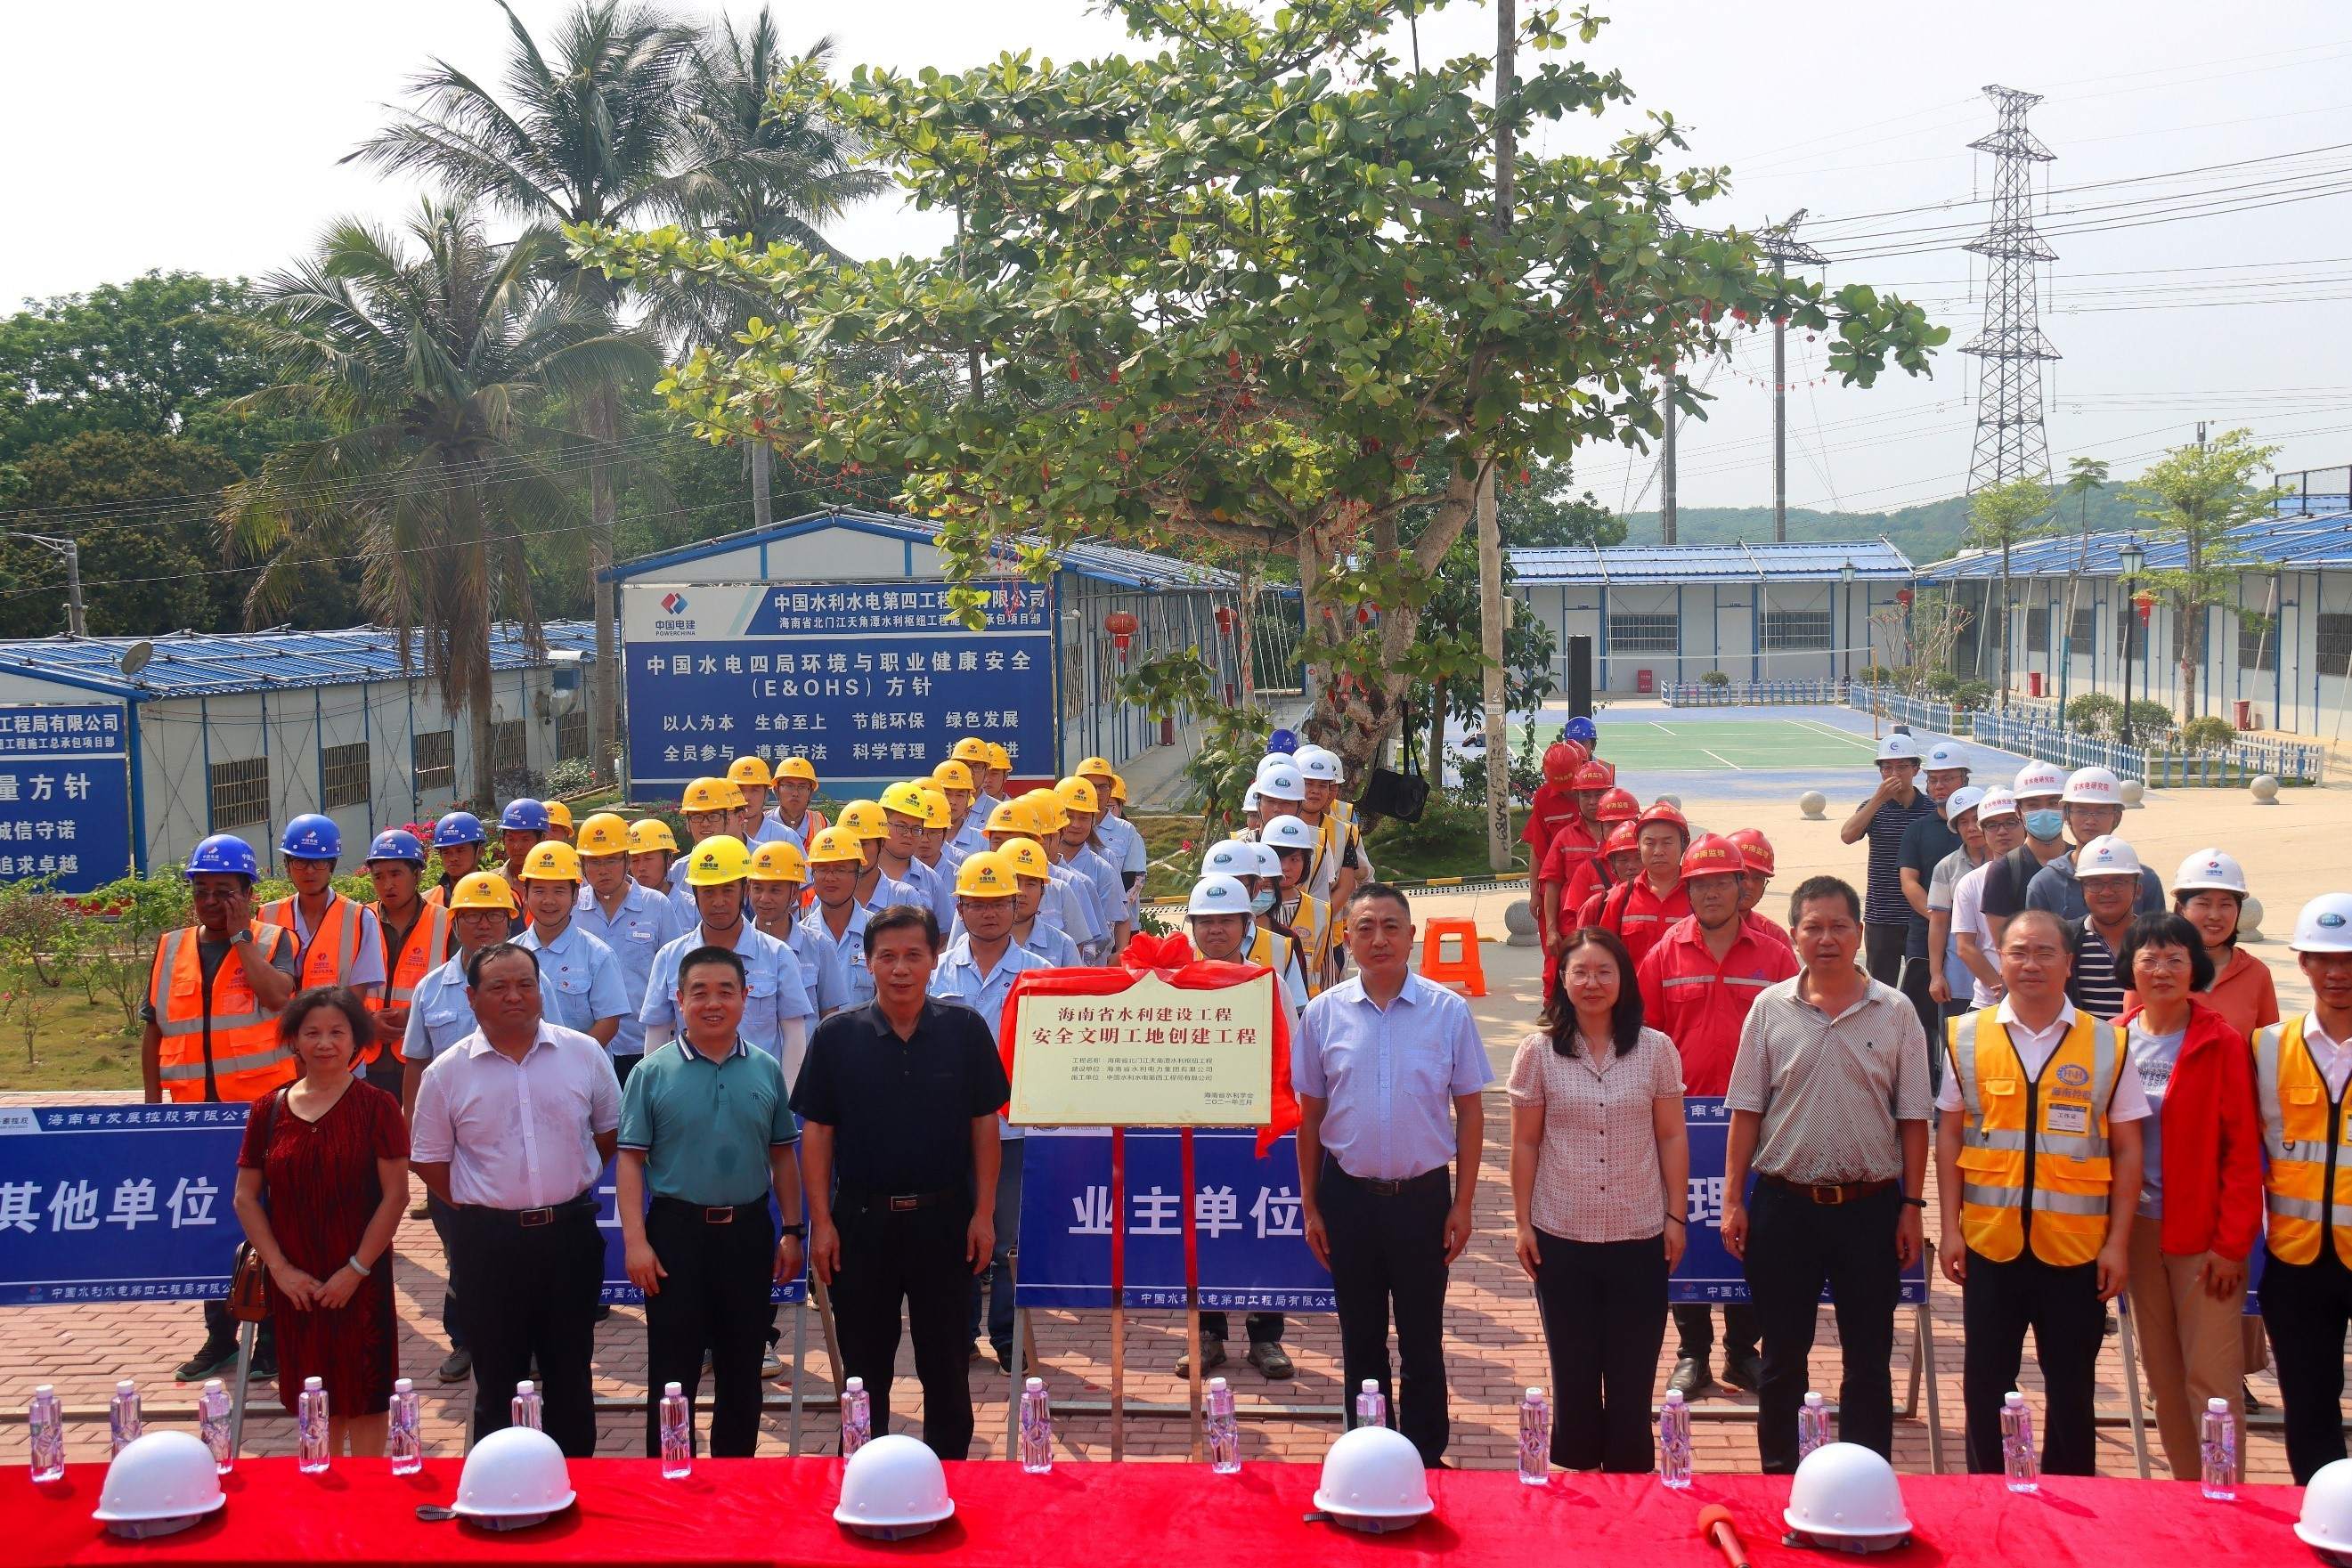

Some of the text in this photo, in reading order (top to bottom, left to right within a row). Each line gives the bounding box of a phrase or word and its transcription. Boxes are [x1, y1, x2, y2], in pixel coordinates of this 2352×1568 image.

[774, 588, 1046, 613] 中国水利水电第四工程有限公司
[655, 620, 696, 630] 中国电建
[779, 612, 1042, 630] 海南省北门江天角潭水利枢纽工程施承包项目部
[647, 650, 1032, 676] 中国水电四局环境与职业健康安全
[0, 713, 118, 734] 工程局有限公司
[663, 711, 1020, 731] 以人为本 生命至上 节能环保 绿色发展
[663, 744, 735, 762] 全员参与
[754, 743, 827, 761] 遵章守法
[852, 743, 926, 760] 科学管理
[0, 773, 92, 801] 量方针
[2072, 781, 2110, 792] 省水电研究院
[1692, 849, 1725, 862] 中南监理
[0, 854, 79, 876] 追求卓越
[1058, 1007, 1233, 1022] 海南省水利建设工程
[1031, 1027, 1257, 1045] 安全文明工地创建工程
[0, 1117, 28, 1125] 南控股
[48, 1109, 251, 1126] 海南省发展控股有限公司
[0, 1175, 219, 1234] 其他单位
[1069, 1185, 1303, 1239] 业主单位
[1707, 1285, 1752, 1298] 中国水
